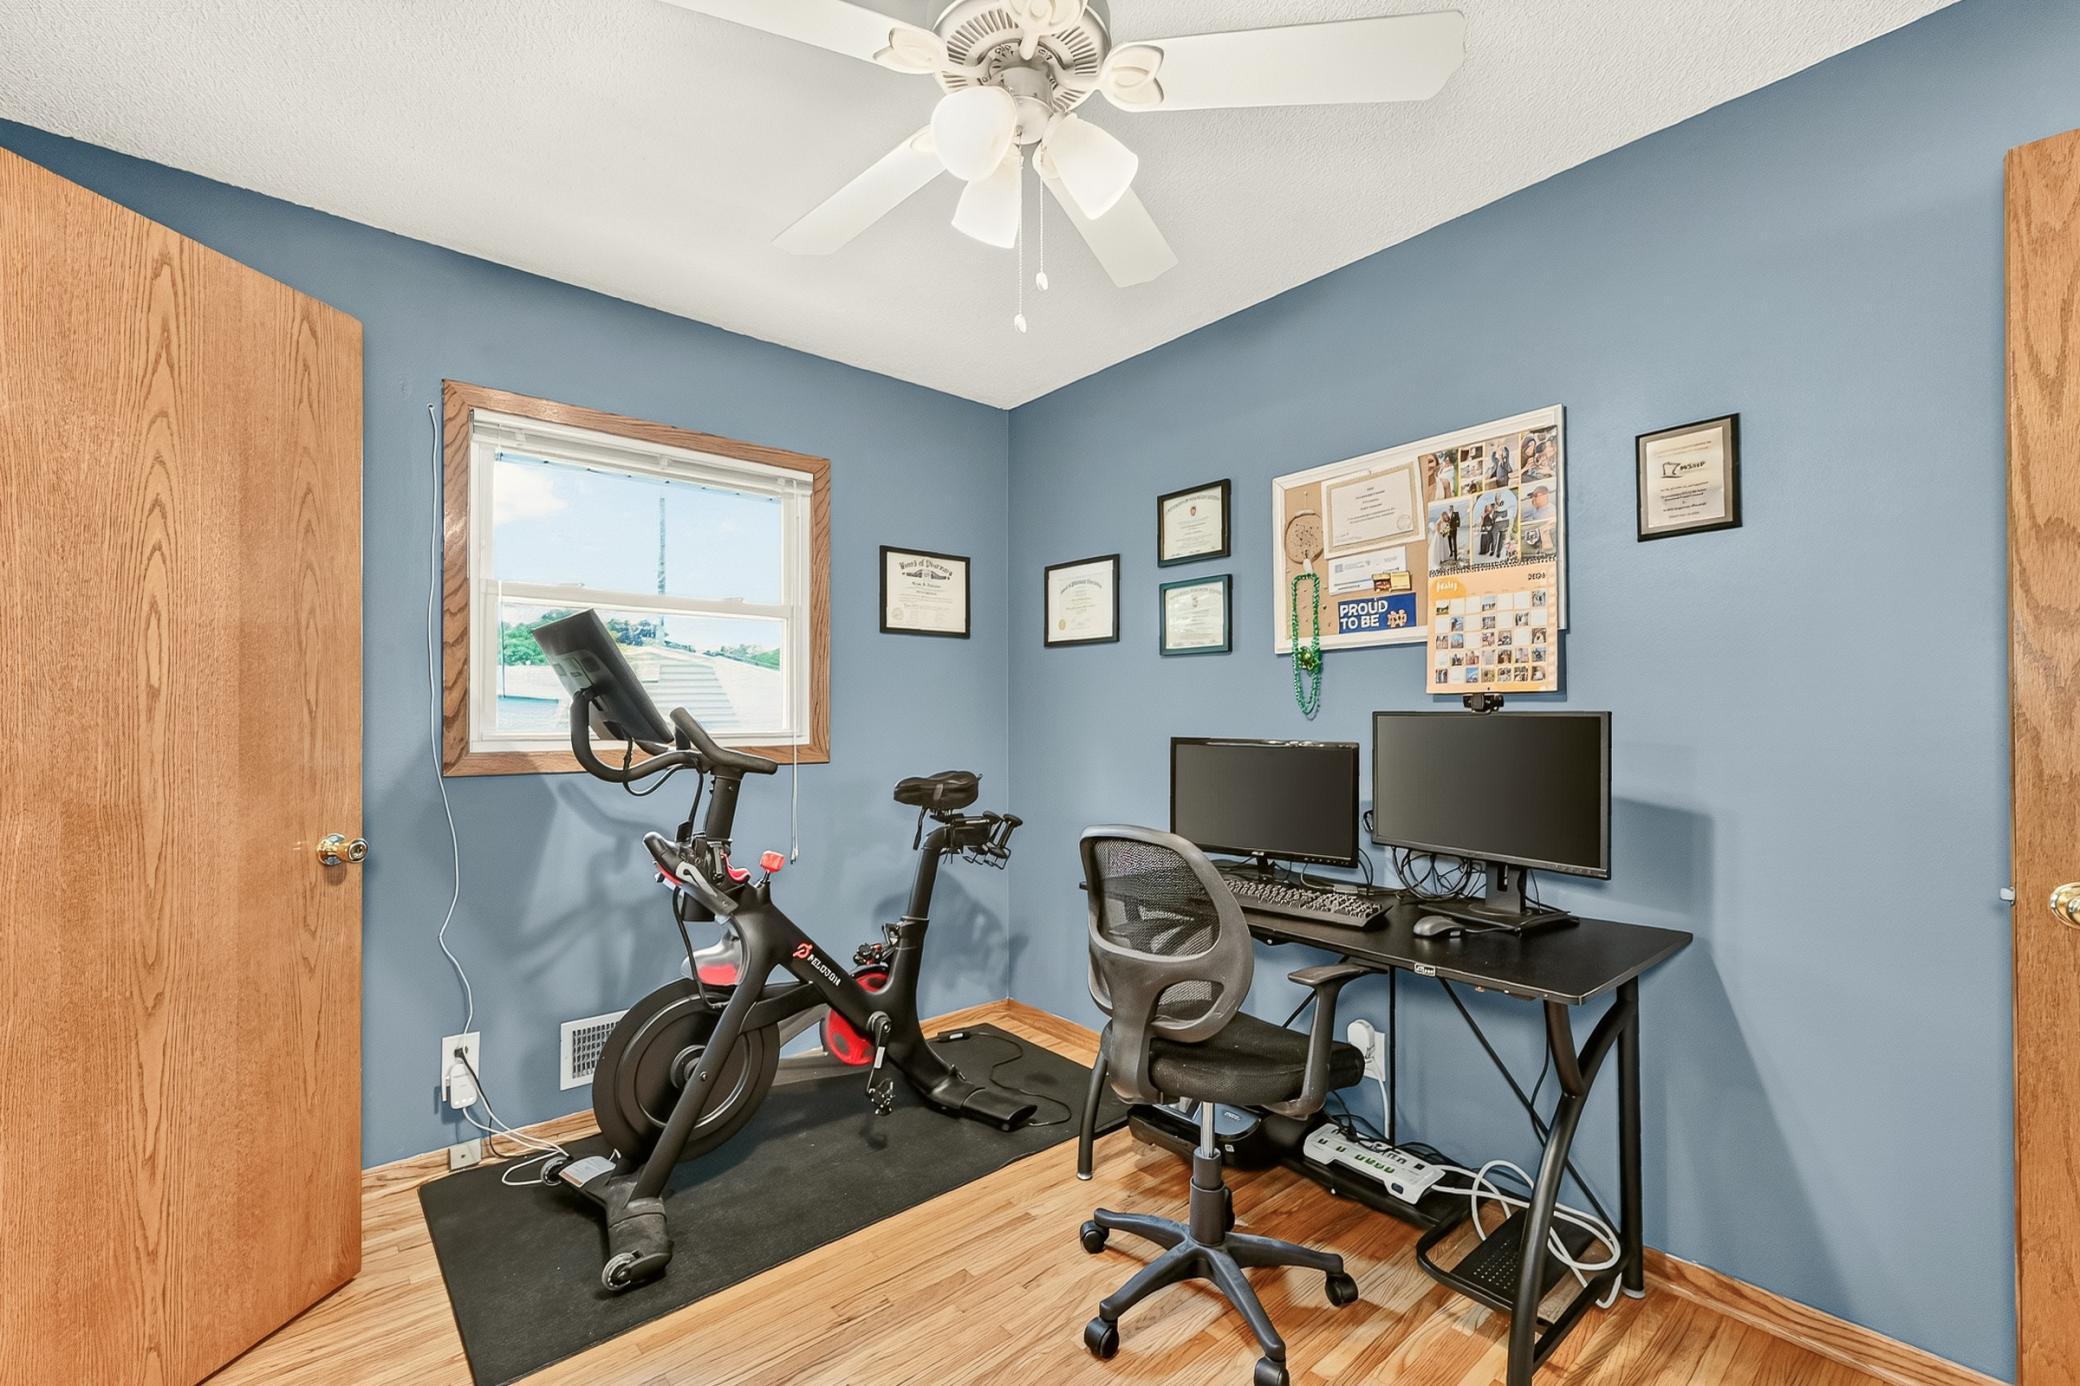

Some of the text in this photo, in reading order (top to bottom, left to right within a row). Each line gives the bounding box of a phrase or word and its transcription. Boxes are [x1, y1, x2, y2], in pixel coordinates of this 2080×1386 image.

[1340, 600, 1388, 617] PROUD
[1340, 614, 1380, 630] TO BE
